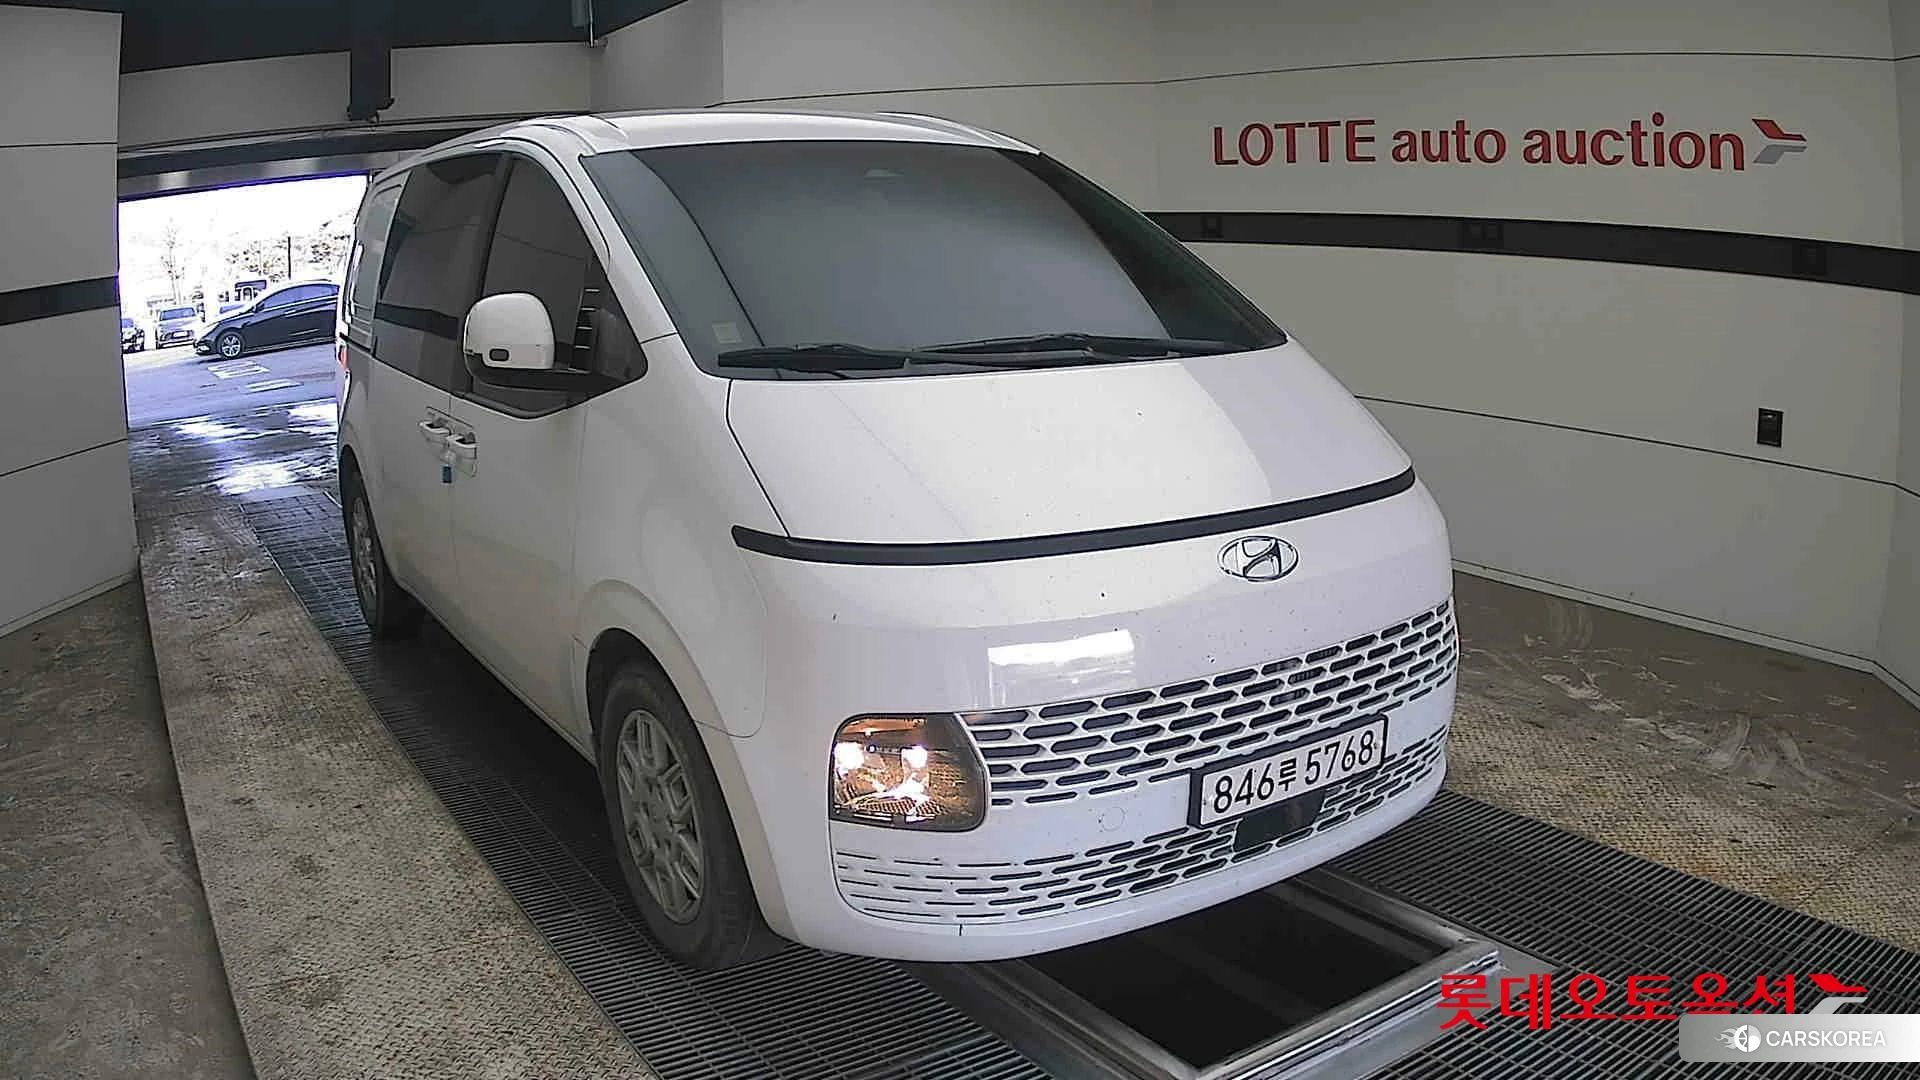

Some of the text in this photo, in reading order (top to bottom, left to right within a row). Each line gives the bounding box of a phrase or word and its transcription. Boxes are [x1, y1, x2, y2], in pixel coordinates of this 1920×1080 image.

[1212, 112, 1746, 171] LOTTE auto auction
